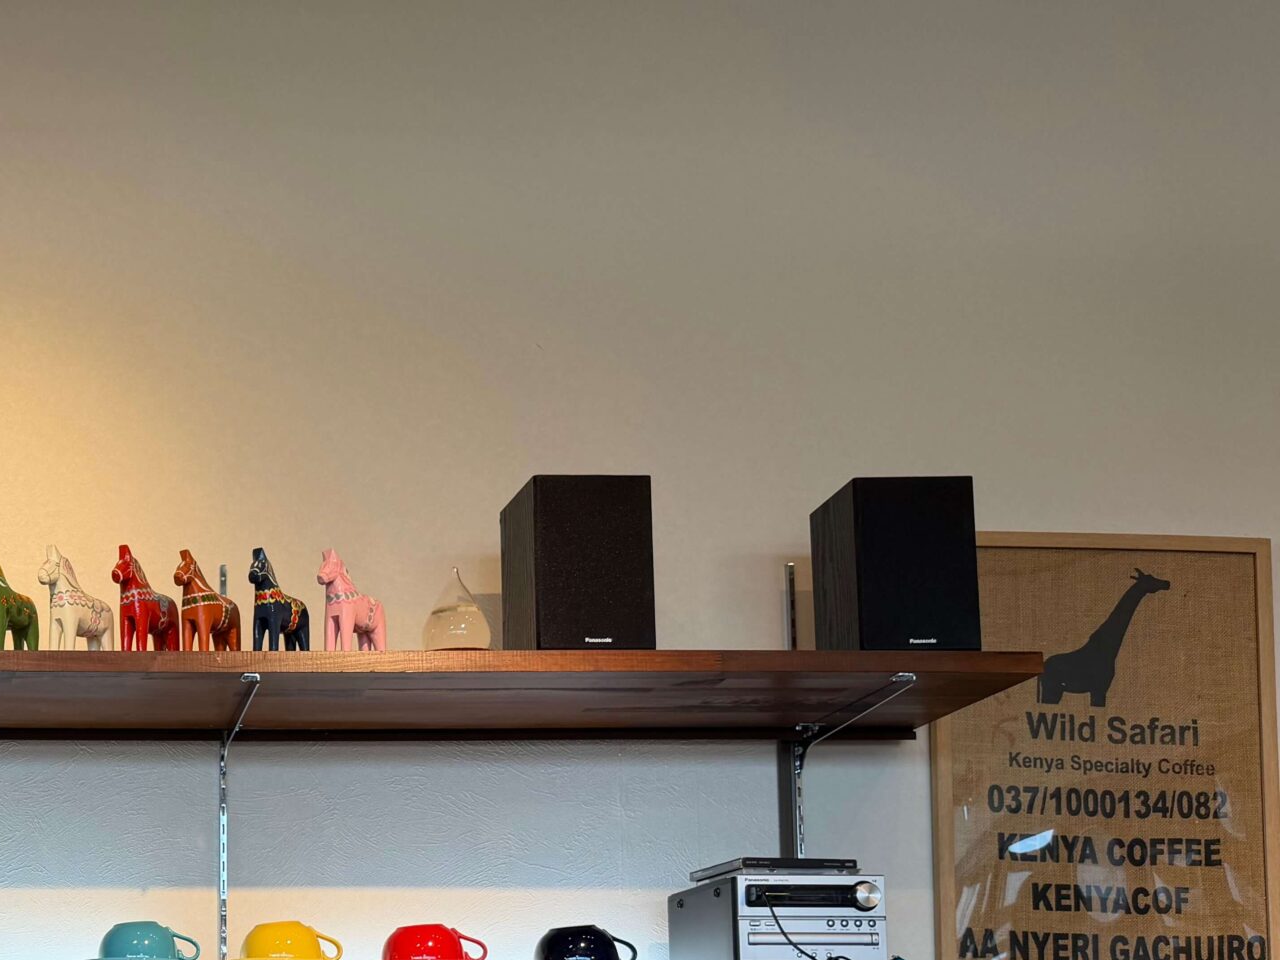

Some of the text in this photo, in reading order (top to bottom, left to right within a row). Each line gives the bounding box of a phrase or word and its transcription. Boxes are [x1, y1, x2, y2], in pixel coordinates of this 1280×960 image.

[1025, 711, 1200, 747] Wild Safari
[1008, 752, 1216, 778] Kenya Specialty Coffee
[987, 784, 1228, 820] 037/1000134/082
[1106, 837, 1223, 867] COFFEE
[1031, 883, 1190, 915] KENYACOF
[958, 927, 1000, 960] AA
